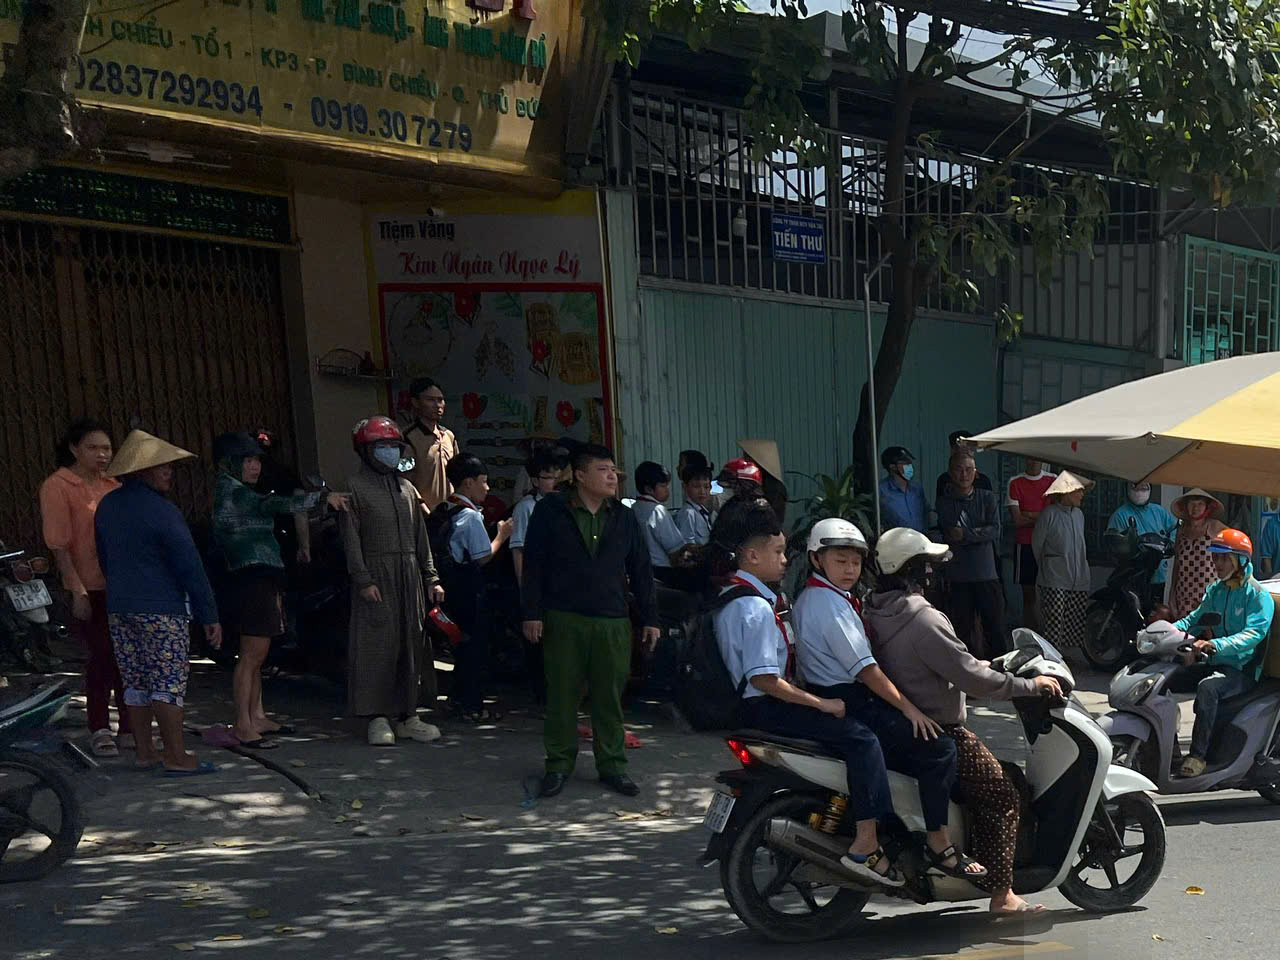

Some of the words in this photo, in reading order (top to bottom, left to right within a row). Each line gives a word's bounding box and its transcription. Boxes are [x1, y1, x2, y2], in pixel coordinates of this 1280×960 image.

[261, 47, 298, 71] KP3
[378, 220, 415, 242] Tiệm
[418, 219, 455, 241] Vàng
[774, 227, 798, 248] TIẾN
[800, 234, 823, 251] THƯ
